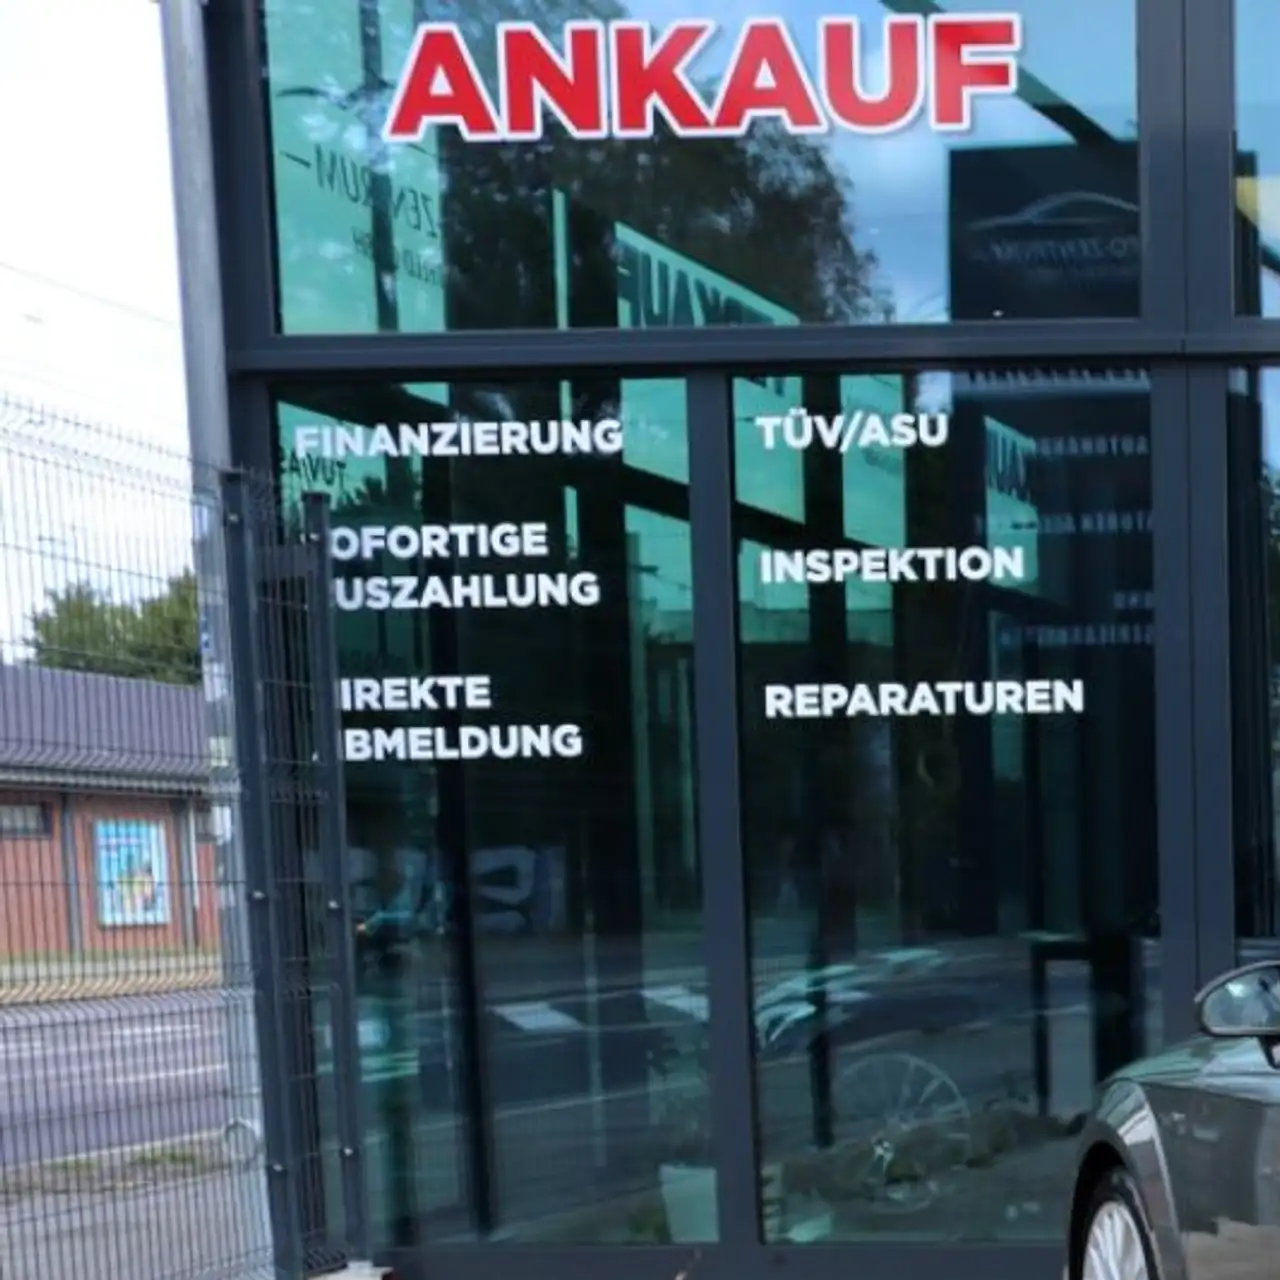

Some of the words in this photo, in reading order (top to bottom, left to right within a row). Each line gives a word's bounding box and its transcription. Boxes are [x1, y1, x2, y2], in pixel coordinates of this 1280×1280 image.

[384, 14, 1020, 144] ANKAUF
[294, 419, 624, 458] FINANZIERUNG
[755, 407, 950, 453] TÜV/ASU
[329, 522, 549, 559] OFORTIGE
[760, 545, 1025, 583] INSPEKTION
[333, 572, 602, 611] USZAHLUNG
[337, 675, 492, 712] IREKTE
[765, 679, 1085, 718] REPARATUREN
[340, 724, 584, 762] BMELDUNG
